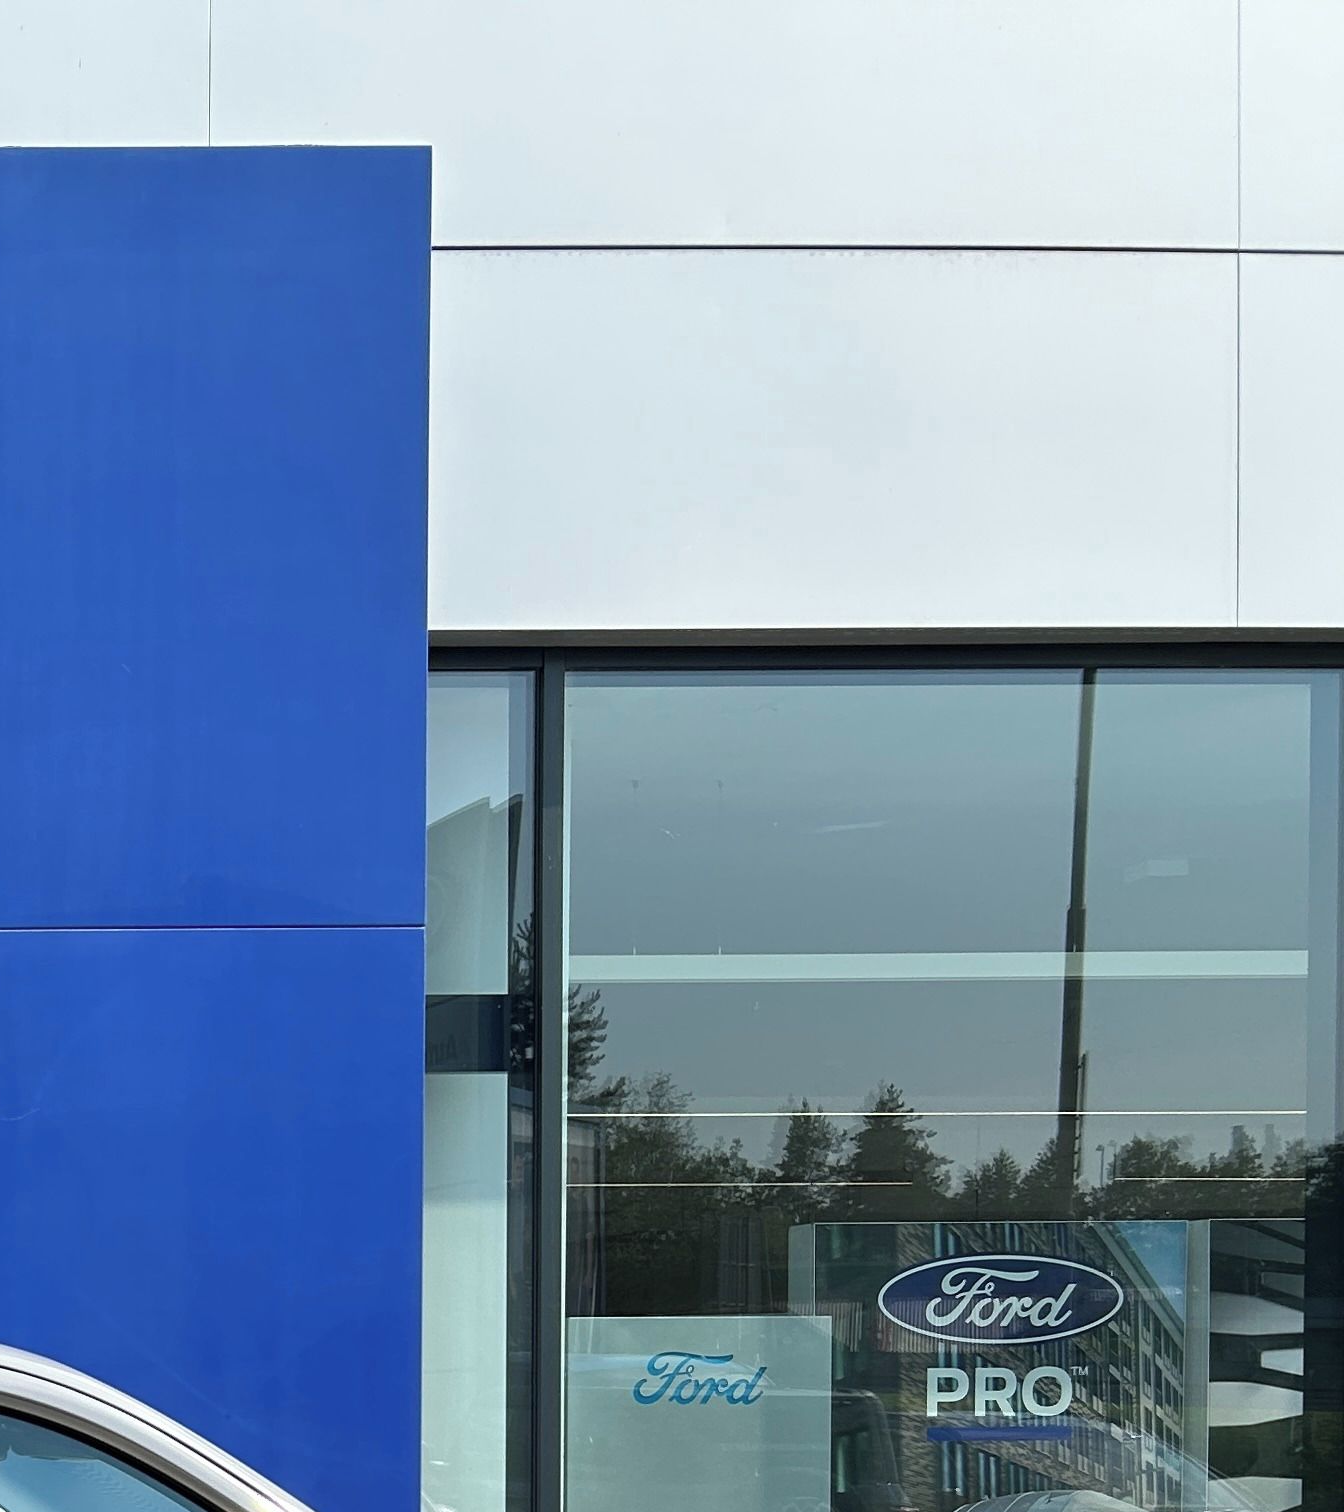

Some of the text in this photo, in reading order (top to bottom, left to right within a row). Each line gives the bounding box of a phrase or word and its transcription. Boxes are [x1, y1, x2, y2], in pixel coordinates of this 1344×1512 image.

[925, 1267, 1078, 1328] Ford
[632, 1351, 768, 1406] Ford
[926, 1365, 1073, 1417] PRO
